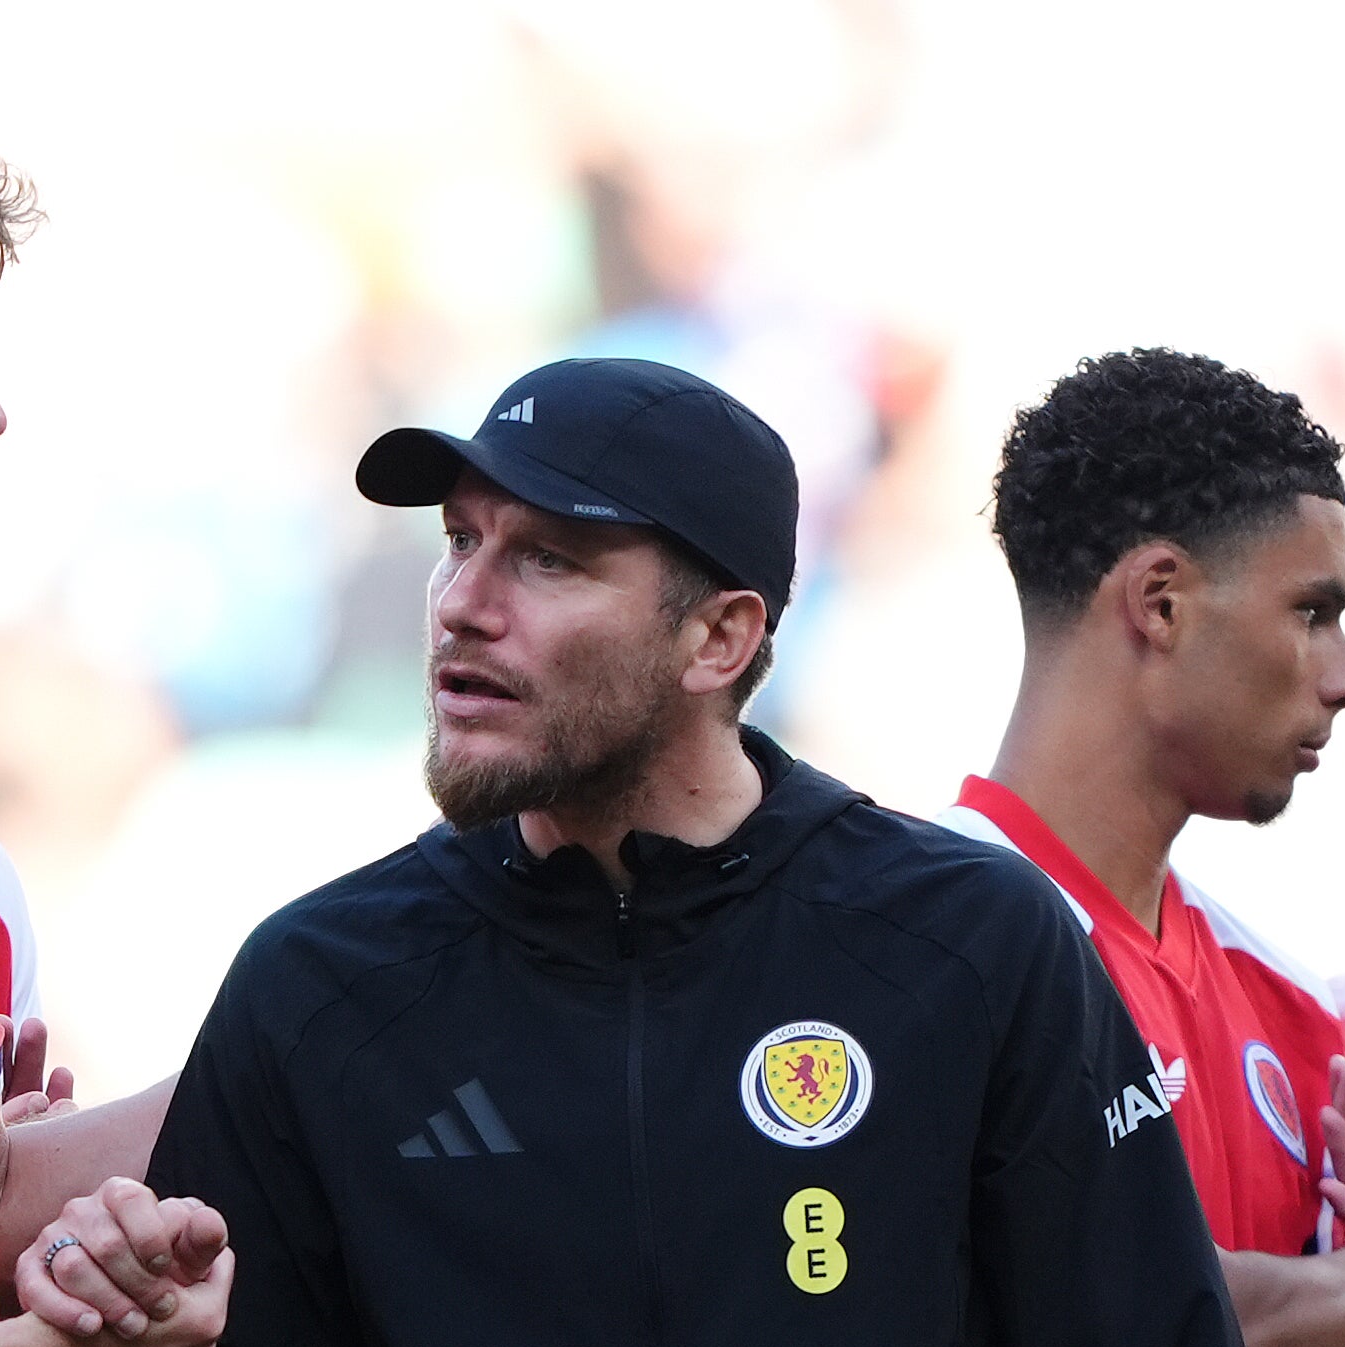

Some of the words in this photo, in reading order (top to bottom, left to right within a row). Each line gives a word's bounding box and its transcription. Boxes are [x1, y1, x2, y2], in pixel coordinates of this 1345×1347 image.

[775, 1024, 833, 1040] SCOTLAND
[762, 1120, 779, 1135] EST
[838, 1113, 857, 1131] 1873
